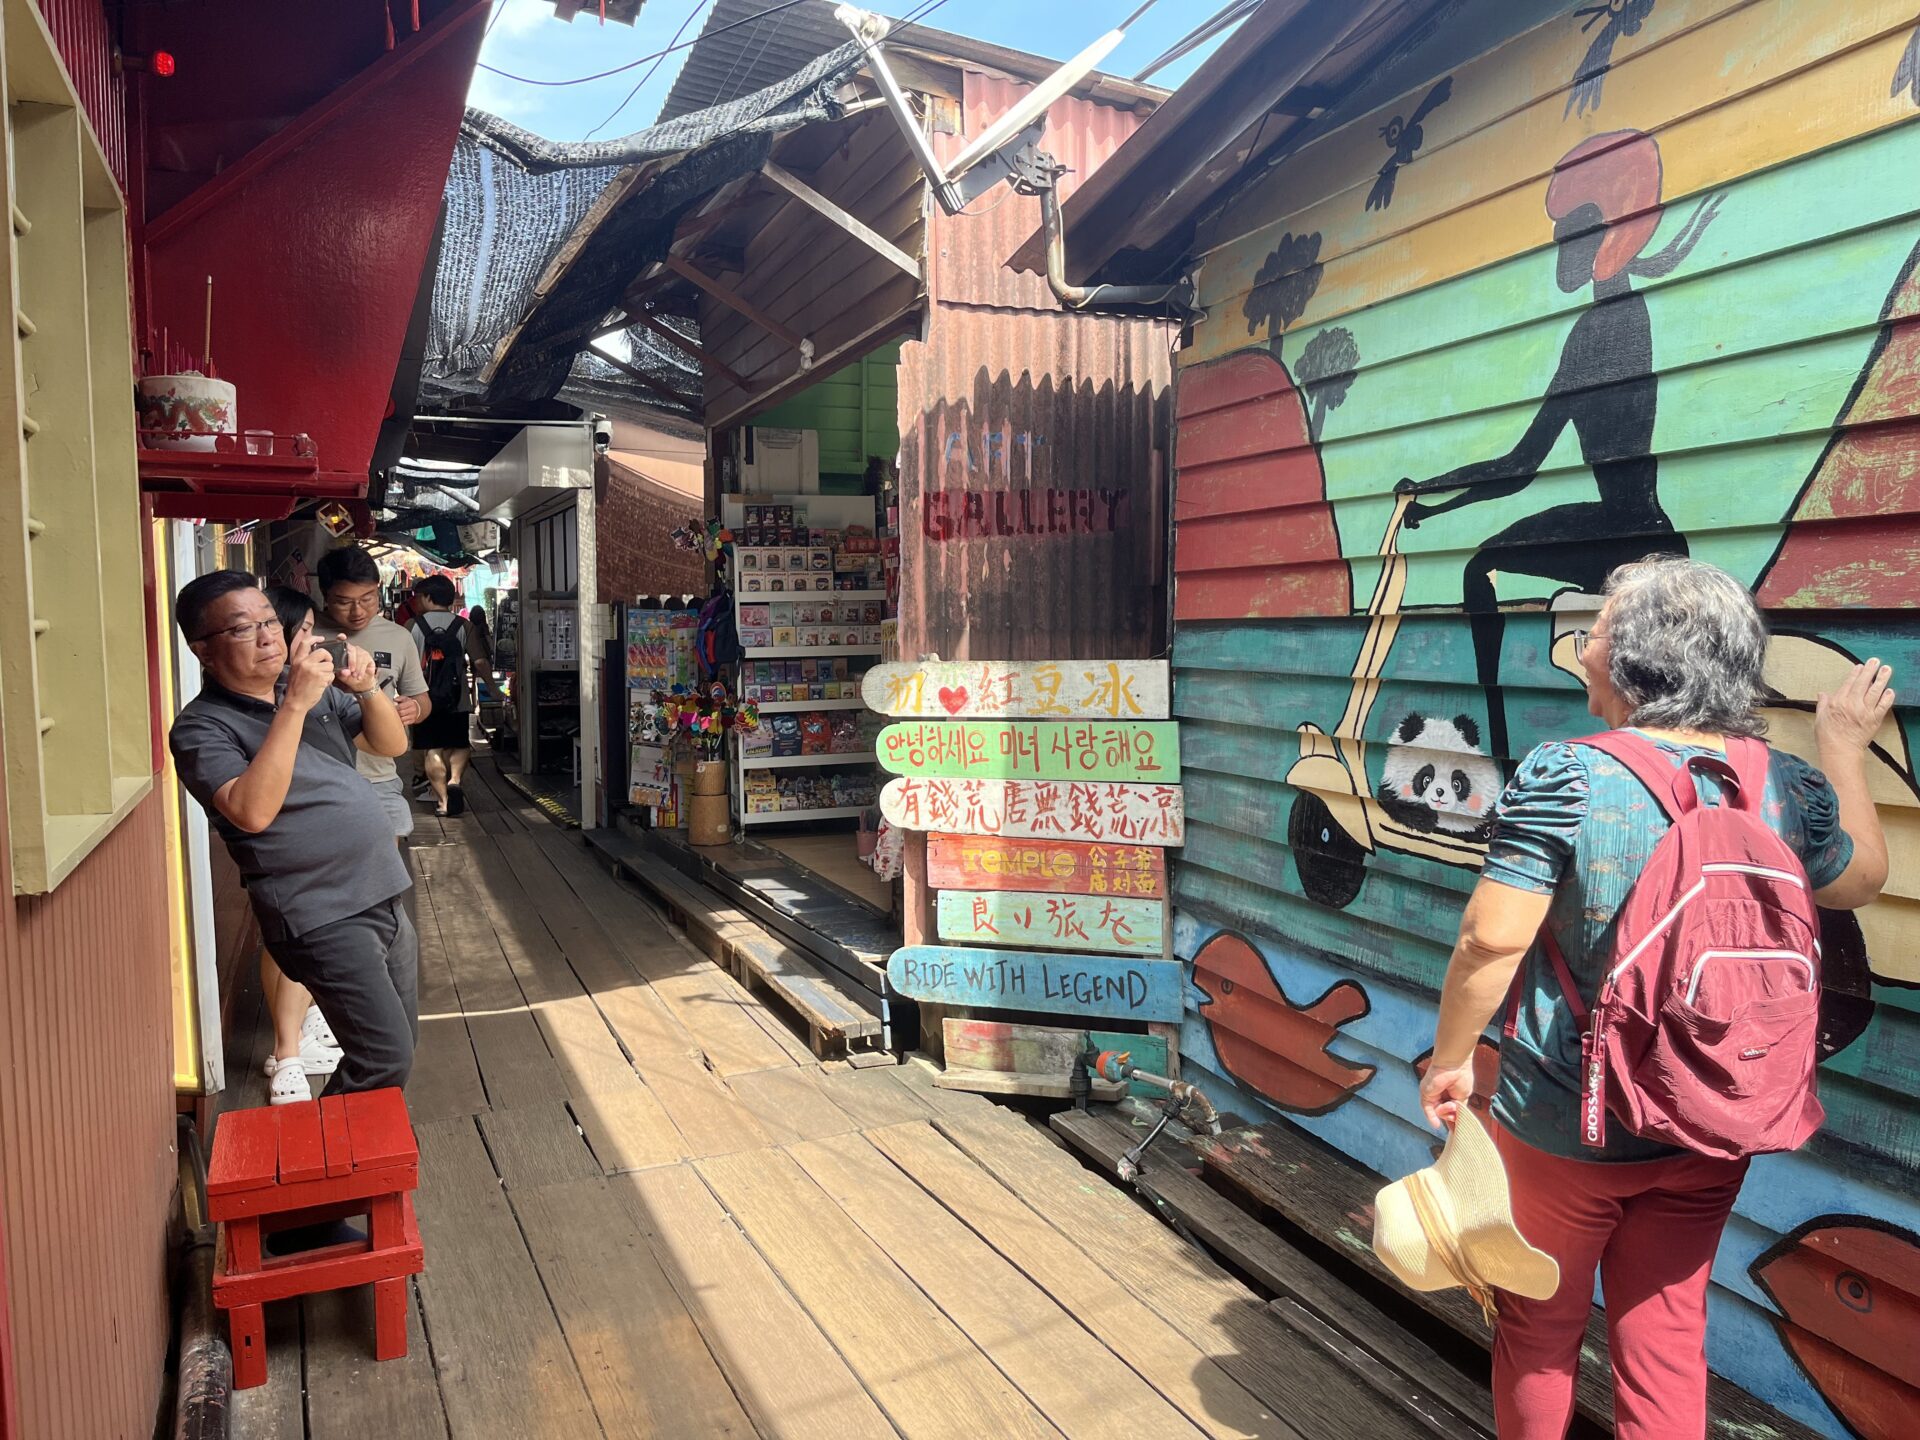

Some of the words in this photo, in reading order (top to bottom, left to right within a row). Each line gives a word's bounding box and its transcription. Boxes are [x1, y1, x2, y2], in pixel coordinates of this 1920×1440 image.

[923, 487, 1127, 541] GALLERY
[885, 725, 989, 769] 안녕하세요
[999, 725, 1040, 772] 미녀
[1051, 723, 1162, 771] 사랑해요
[904, 958, 958, 990] RIDE
[963, 958, 1026, 996] WITH
[1041, 962, 1148, 1010] LEGEND
